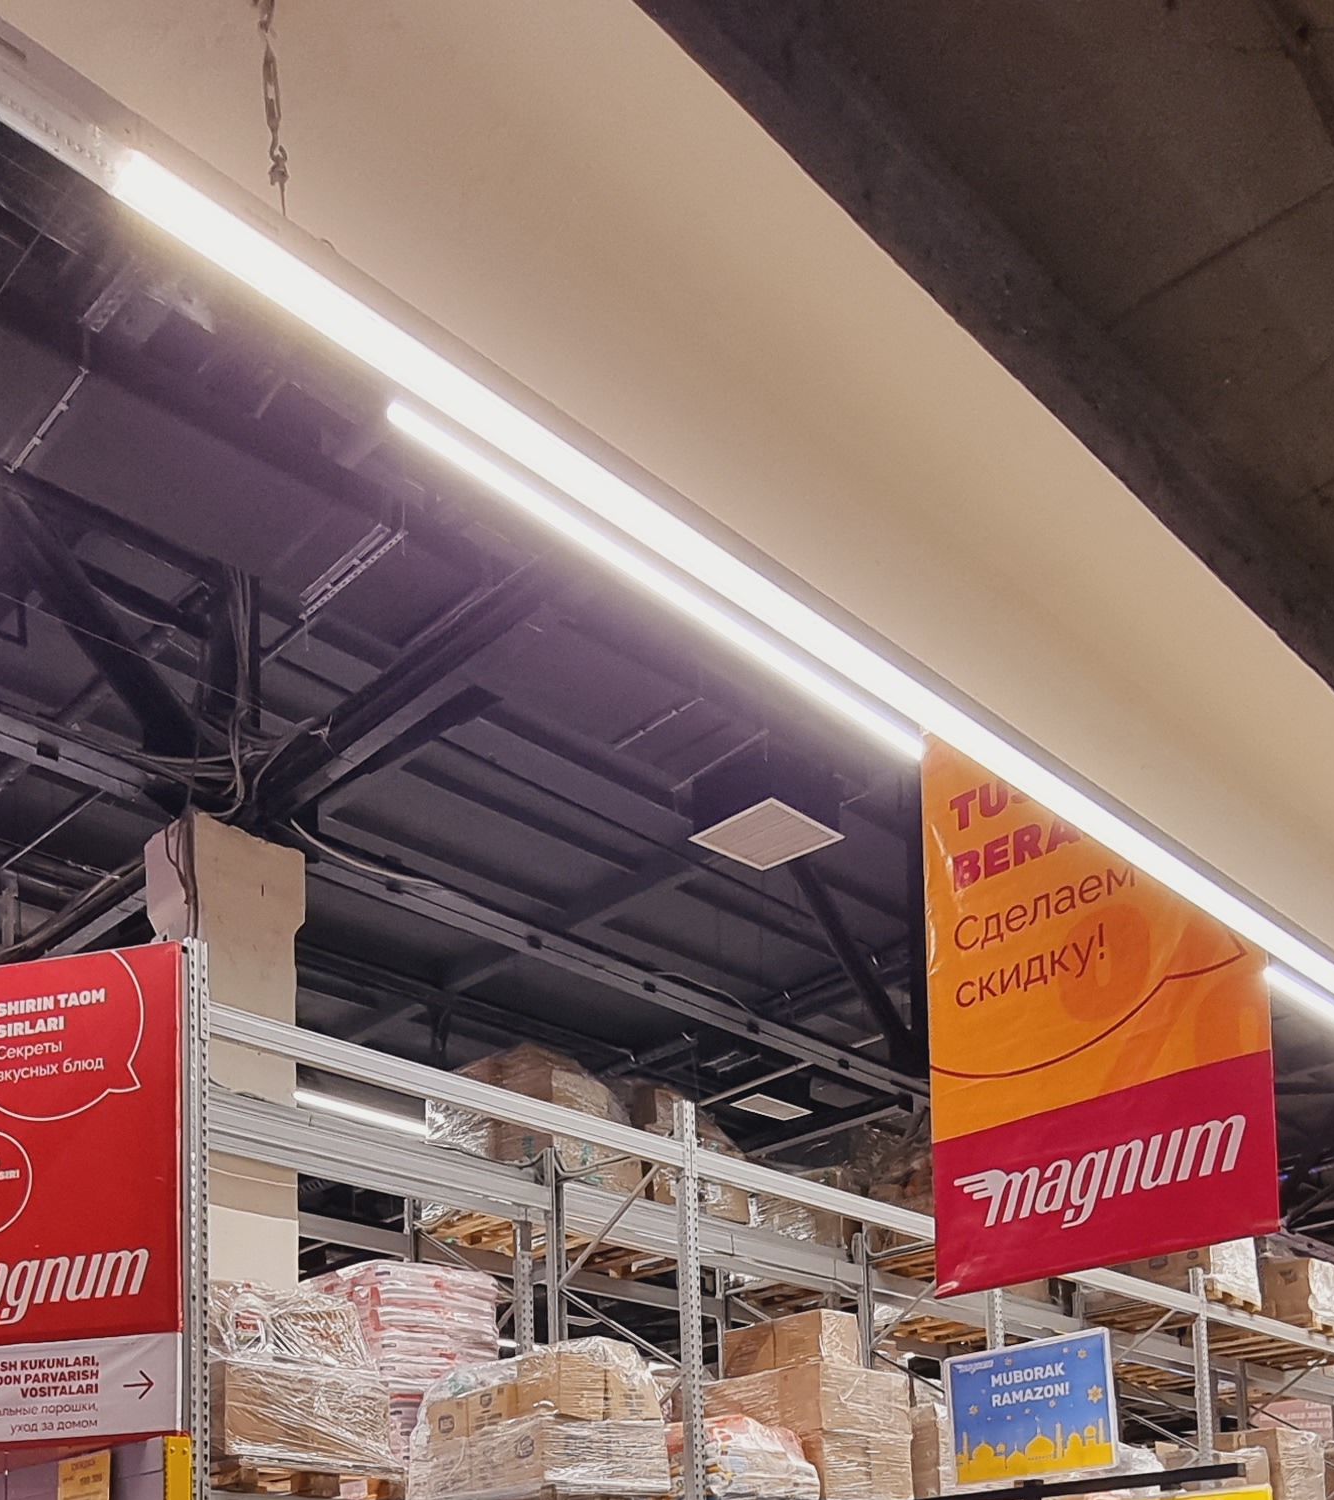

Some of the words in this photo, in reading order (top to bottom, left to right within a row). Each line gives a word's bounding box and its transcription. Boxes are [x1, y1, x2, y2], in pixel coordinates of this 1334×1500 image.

[952, 818, 1081, 893] BERA
[954, 867, 1135, 951] Сделаем
[955, 923, 1105, 1008] скидку!
[57, 988, 106, 1009] TAOM
[62, 1057, 104, 1073] блюд
[954, 1114, 1247, 1230] magnum
[20, 1355, 100, 1371] KUKUNLARI,
[24, 1369, 99, 1385] PARVARISH
[990, 1362, 1065, 1388] MUBORAK
[20, 1383, 99, 1399] VOSITALARI
[992, 1381, 1070, 1408] RAMAZON!
[10, 1422, 39, 1436] уход
[41, 1421, 54, 1432] за
[57, 1418, 98, 1432] домом
